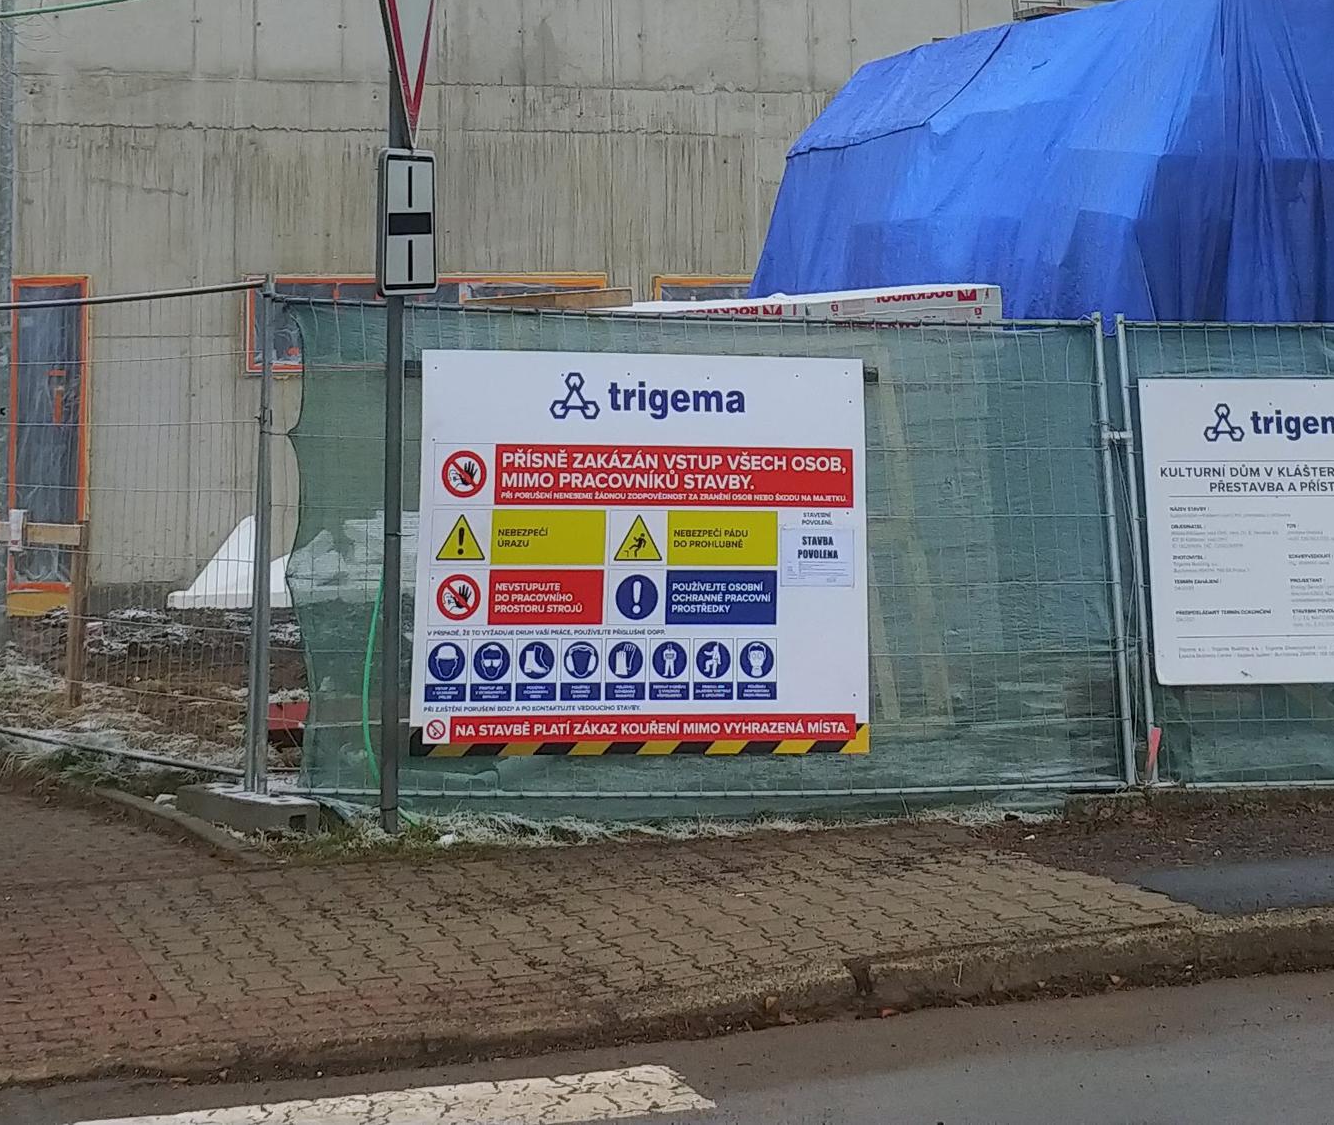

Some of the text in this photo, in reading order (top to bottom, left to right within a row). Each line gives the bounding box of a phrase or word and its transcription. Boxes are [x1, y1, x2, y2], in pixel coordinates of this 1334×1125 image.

[608, 381, 746, 420] trigema
[502, 449, 847, 474] PŘÍSNĚ ZAKÁZÁN VSTUP VŠECH OSOB,
[1160, 464, 1226, 477] KULTURNÍ
[1230, 464, 1260, 477] DŮM
[1264, 466, 1273, 477] V
[501, 469, 754, 490] MIMO PRACOVNÍKŮ STAVBY.
[1209, 480, 1285, 492] PŘESTAVBA
[1287, 482, 1297, 491] A
[514, 491, 553, 500] PORUŠENÍ
[732, 493, 752, 501] OSOB
[801, 494, 812, 502] NA
[497, 527, 548, 537] NEBEZPEČÍ
[673, 528, 748, 537] NEBEZPEČÍ PÁDU
[497, 538, 530, 547] ÚRAZU
[673, 539, 744, 548] DO PROHLUBNĚ
[802, 536, 834, 546] STAVBA
[797, 549, 839, 559] POVOLENA
[495, 583, 560, 591] NEVSTUPUJTE
[672, 581, 763, 591] POUŽÍVEJTE OSOBNÍ
[494, 593, 573, 602] DO PRACOVNÍHO
[671, 592, 771, 602] OCHRANNÉ PRACOVNÍ
[494, 603, 583, 613] PROSTORU STROJŮ
[671, 603, 731, 613] PROSTŘEDKY
[455, 718, 849, 736] NA STAVBĚ PLATÍ ZÁKAZ KOUŘENÍ MIMO VYHRAZENÁ MÍSTA.
